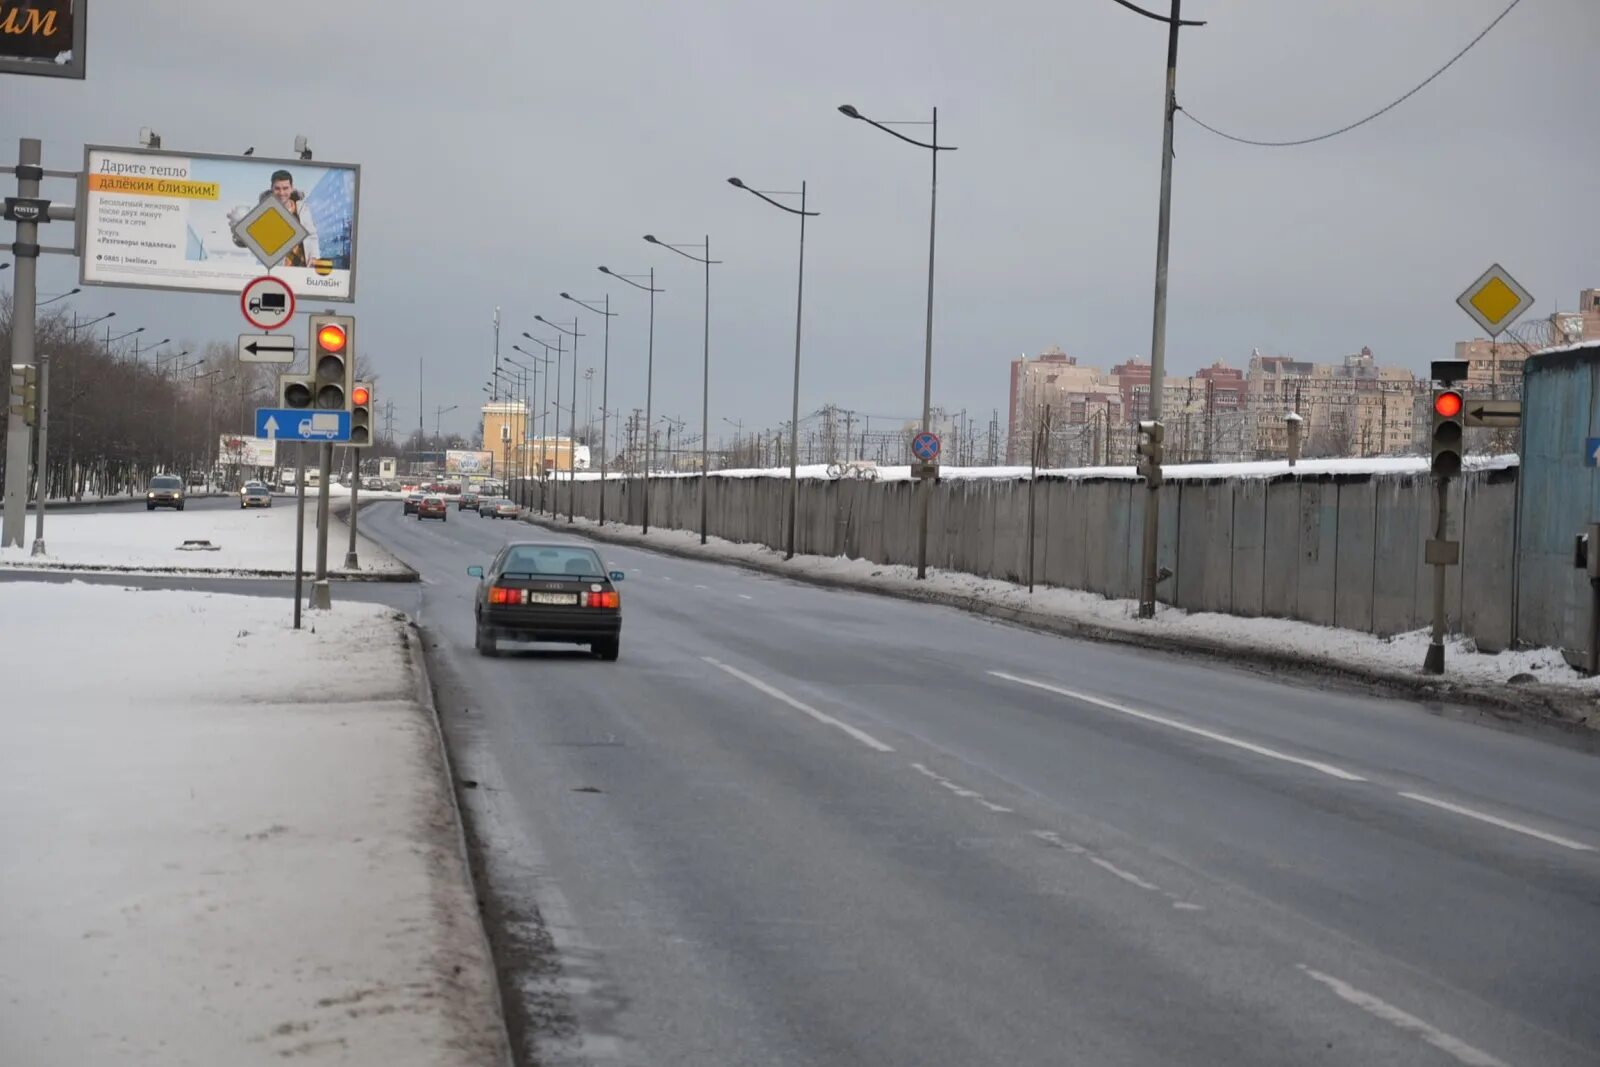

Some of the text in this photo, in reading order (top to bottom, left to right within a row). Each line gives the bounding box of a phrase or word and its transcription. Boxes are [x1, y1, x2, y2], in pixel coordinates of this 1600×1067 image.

[100, 159, 187, 177] Дарите тепло
[99, 177, 215, 196] далёким близким!
[99, 197, 180, 211] Бесплатный межгород
[98, 207, 120, 215] после
[140, 211, 162, 219] минут
[97, 228, 119, 237] Услуга
[125, 257, 158, 265] beeline.ru
[306, 276, 340, 288] Билайн
